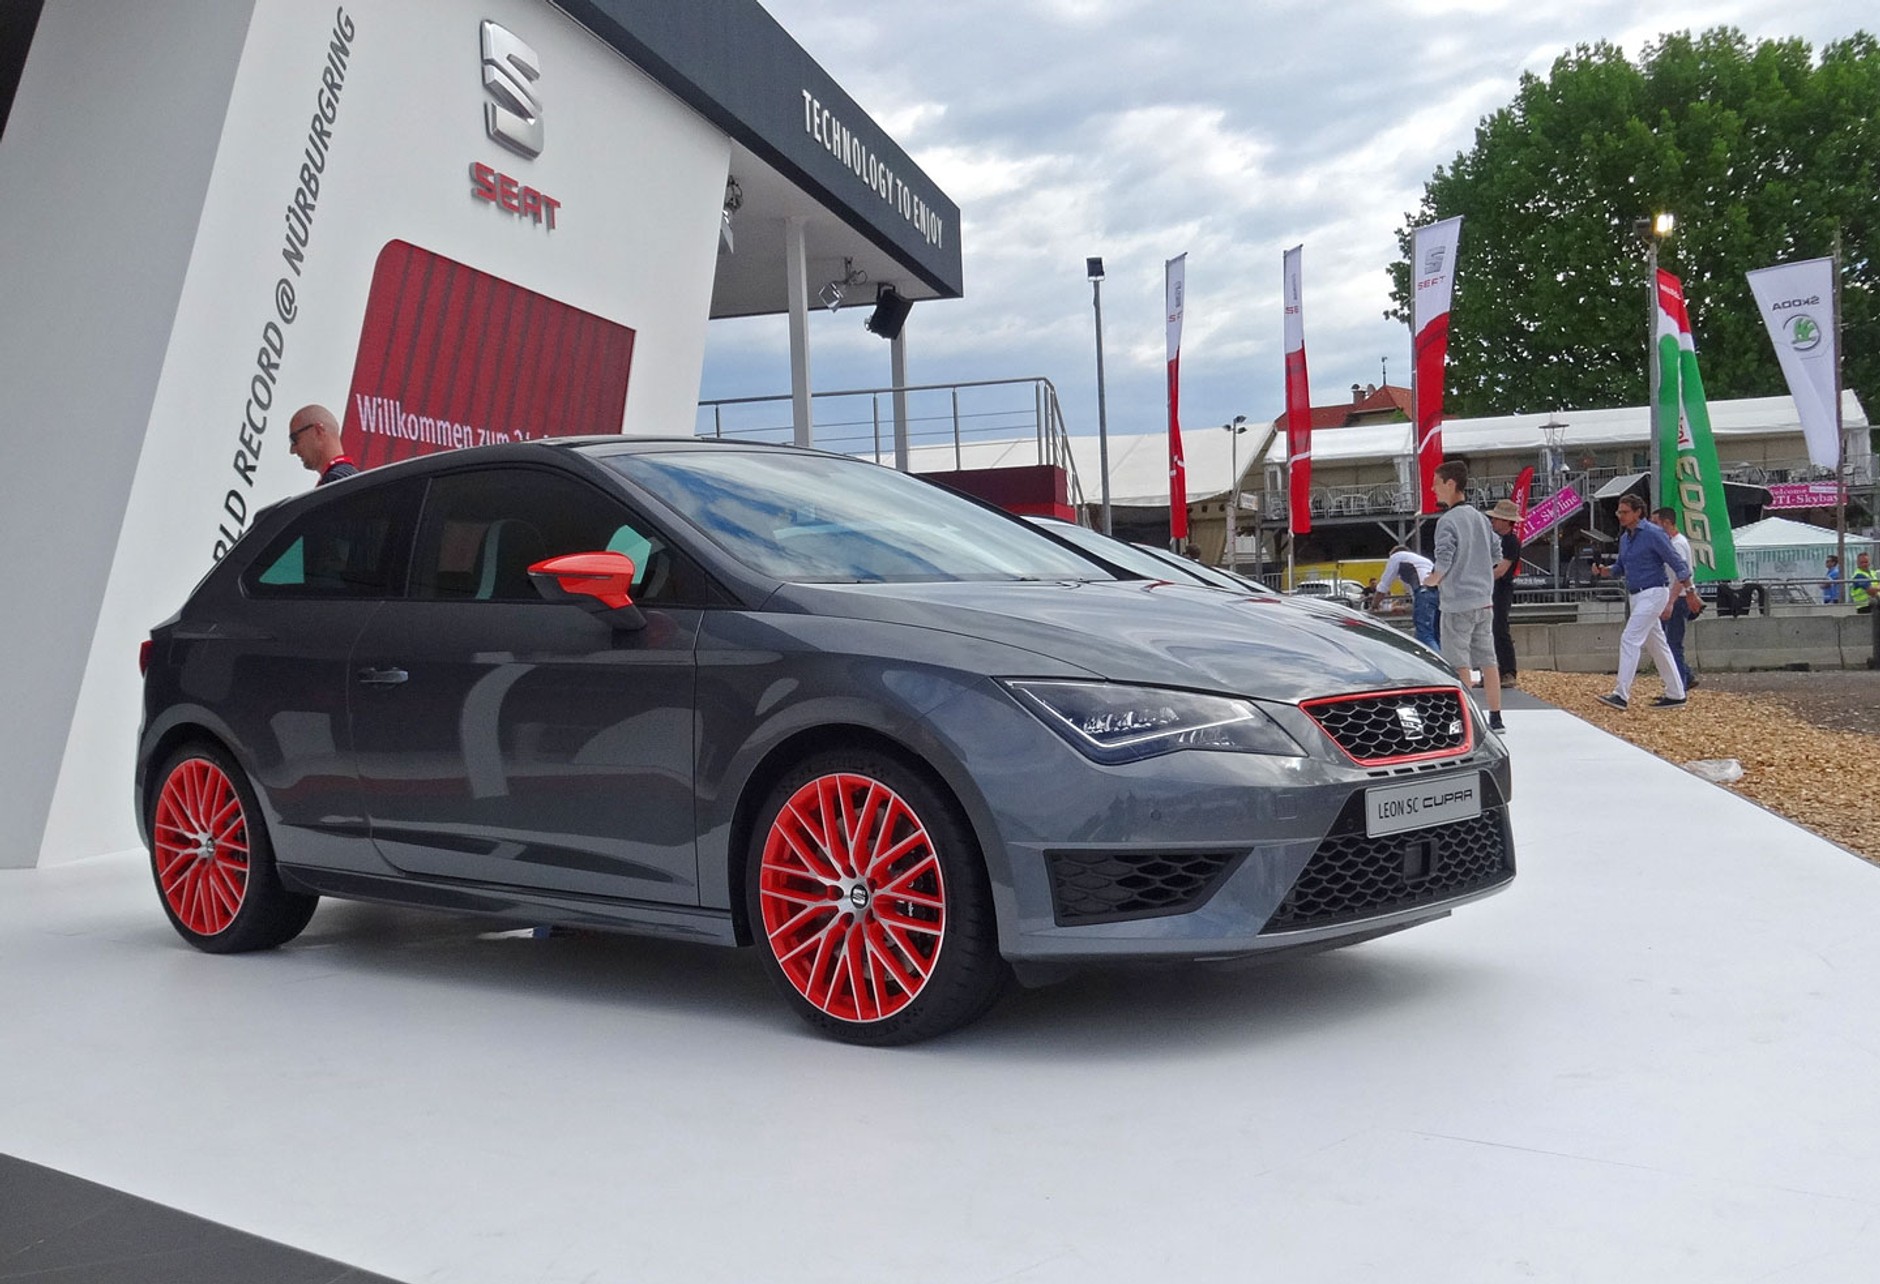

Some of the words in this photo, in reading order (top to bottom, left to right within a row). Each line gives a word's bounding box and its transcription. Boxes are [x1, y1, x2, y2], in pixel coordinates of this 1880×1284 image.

[282, 6, 355, 277] NÜRBURGRING
[802, 88, 894, 205] TECHNOLOGY
[896, 178, 911, 220] TO
[913, 195, 943, 249] ENJOY
[470, 161, 562, 232] SEAT
[275, 278, 298, 325] @
[233, 321, 284, 487] RECORD
[356, 393, 474, 449] Willkommen
[477, 428, 511, 448] zum
[1677, 456, 1716, 571] EDGE
[1378, 801, 1405, 819] LEON
[1406, 797, 1419, 814] SC
[1422, 789, 1473, 808] CUPRA
